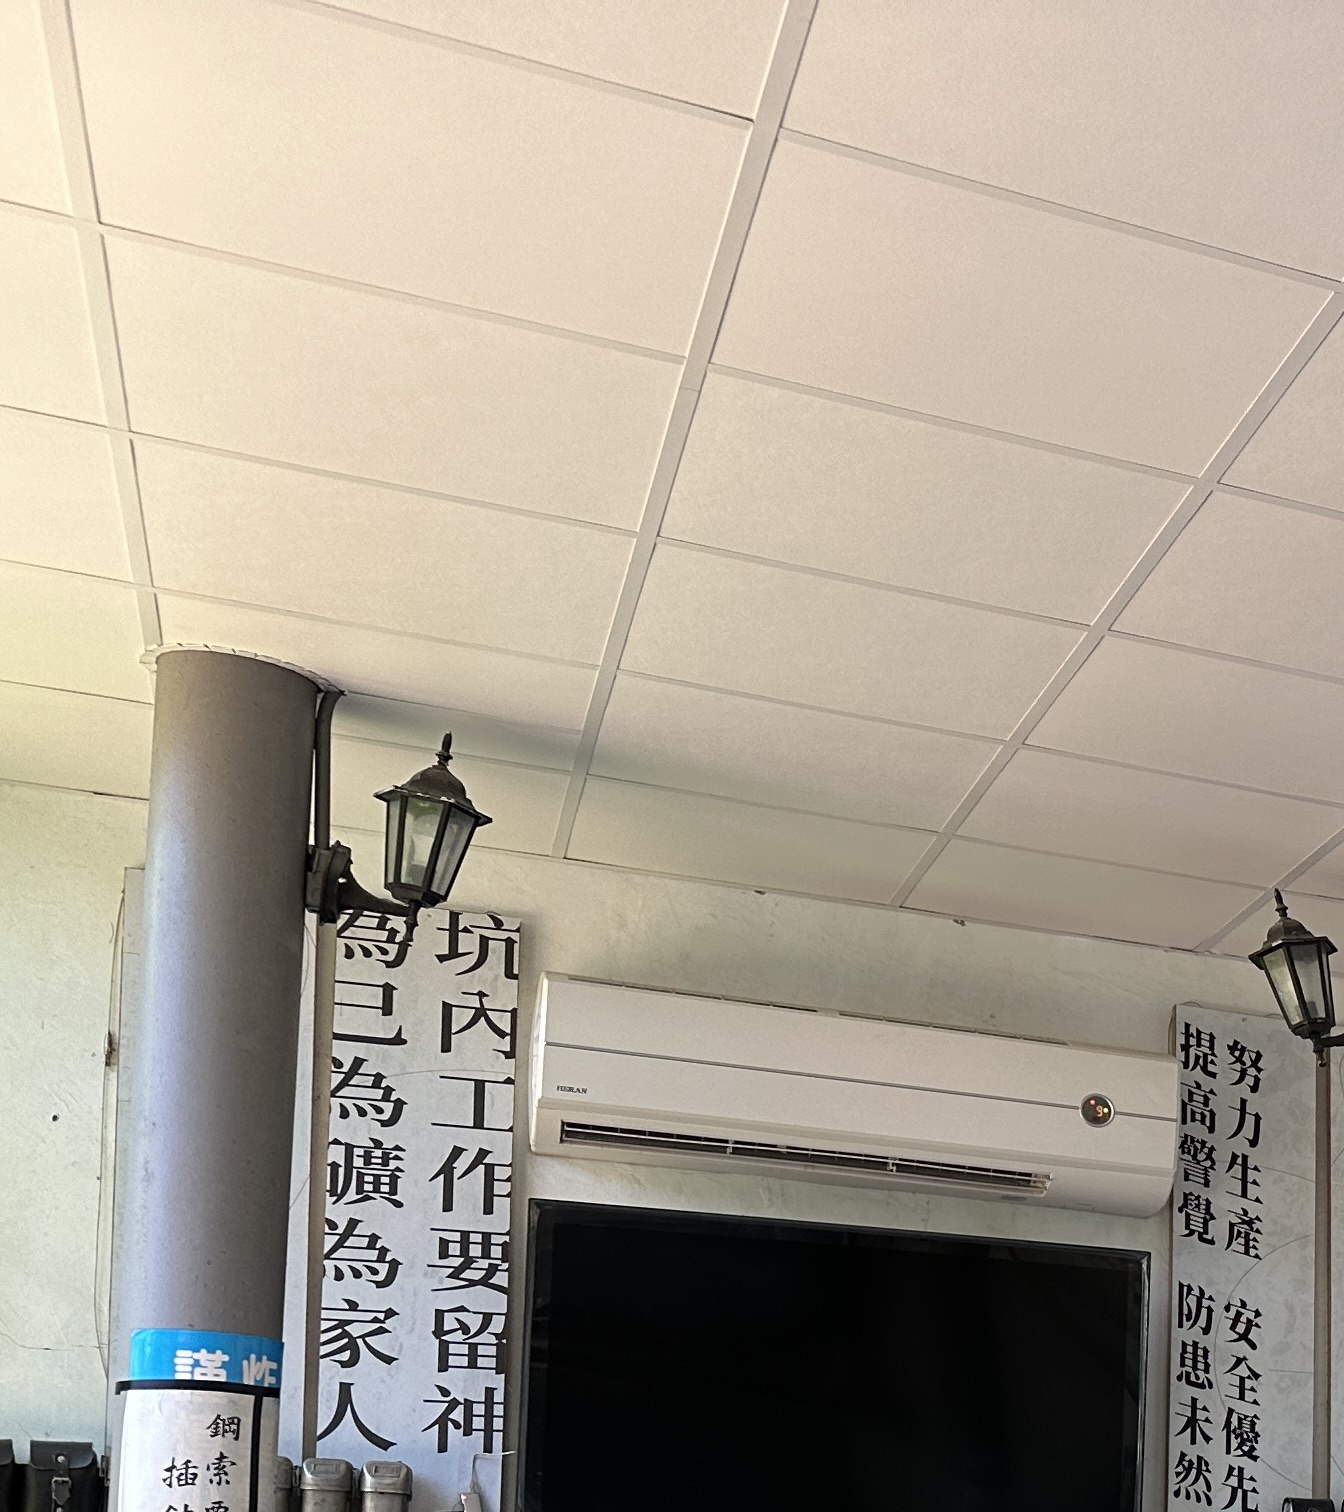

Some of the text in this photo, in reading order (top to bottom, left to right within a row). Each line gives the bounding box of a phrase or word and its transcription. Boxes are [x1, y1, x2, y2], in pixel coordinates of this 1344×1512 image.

[422, 911, 519, 1455] 坑內工作要留神
[1174, 1021, 1218, 1507] 提高警覺 防患未然
[1225, 1039, 1264, 1261] 努力生產
